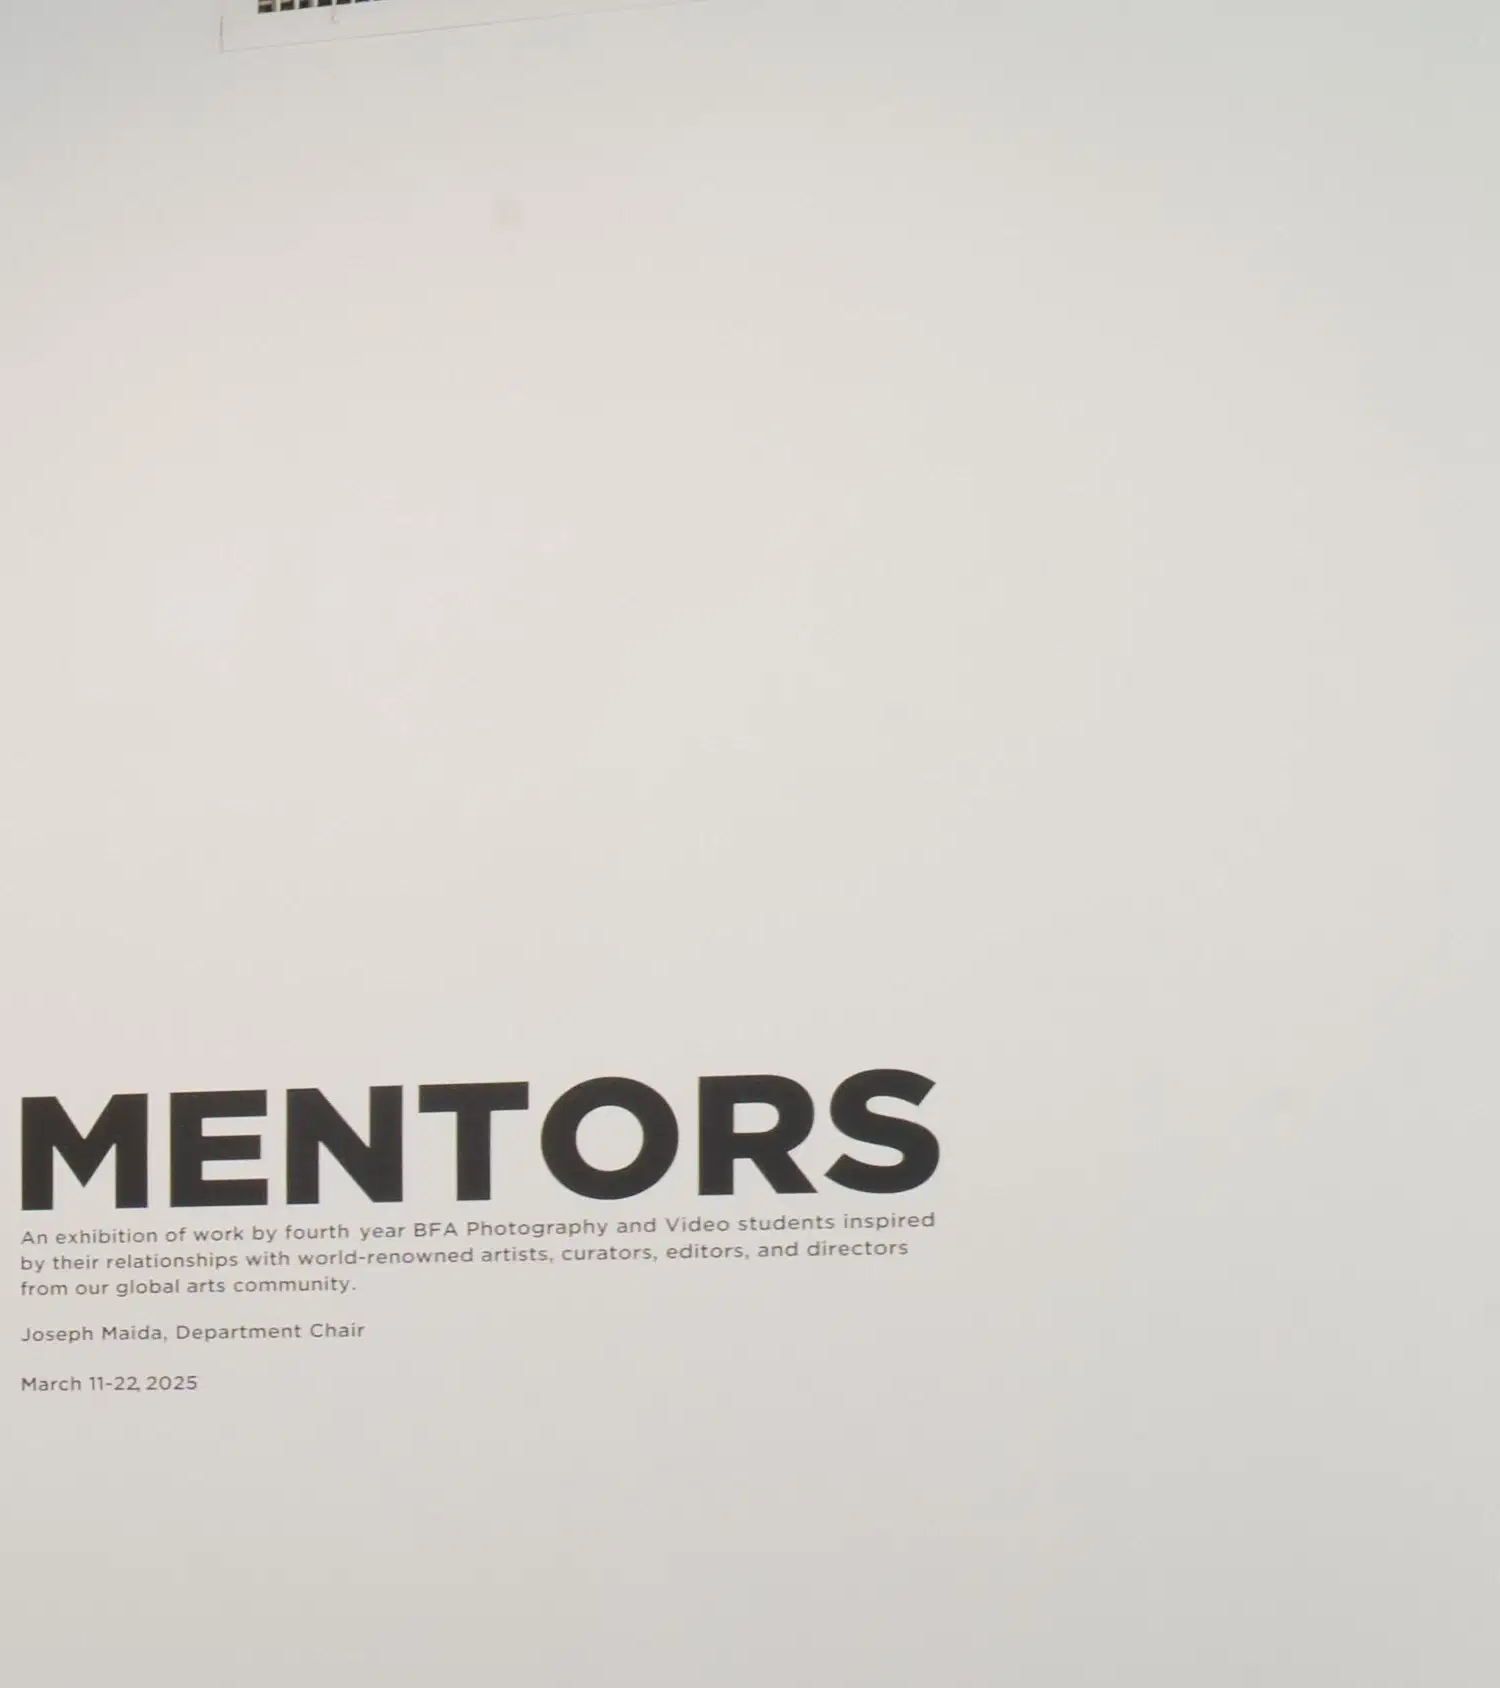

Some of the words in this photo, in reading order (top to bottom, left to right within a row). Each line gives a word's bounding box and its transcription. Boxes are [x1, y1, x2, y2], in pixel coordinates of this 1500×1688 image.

[21, 1068, 940, 1211] MENTORS
[21, 1231, 48, 1244] An
[56, 1229, 157, 1244] exhibition
[166, 1227, 186, 1242] of
[193, 1226, 243, 1241] work
[252, 1226, 277, 1243] by
[286, 1224, 349, 1240] fourth
[360, 1227, 406, 1241] year
[414, 1222, 458, 1237] BFA
[468, 1219, 608, 1238] Photography
[617, 1218, 656, 1233] and
[666, 1217, 729, 1232] Video
[738, 1215, 835, 1231] students
[844, 1212, 935, 1230] inspired
[21, 1256, 45, 1273] by
[52, 1255, 99, 1270] their
[107, 1252, 238, 1269] relationships
[246, 1251, 289, 1266] with
[298, 1247, 473, 1265] world-renowned
[481, 1247, 554, 1263] artists,
[562, 1246, 657, 1262] curators,
[666, 1244, 749, 1259] editors,
[758, 1242, 798, 1257] and
[807, 1240, 908, 1256] directors
[21, 1281, 67, 1296] from
[76, 1284, 109, 1295] our
[116, 1279, 180, 1297] global
[187, 1280, 225, 1293] arts
[234, 1276, 356, 1294] community.
[21, 1326, 93, 1344] Joseph
[102, 1325, 168, 1342] Maida,
[176, 1325, 301, 1342] Department
[310, 1323, 365, 1337] Chair
[21, 1376, 81, 1391] March
[89, 1376, 140, 1392] 11-22,
[146, 1376, 197, 1390] 2025
